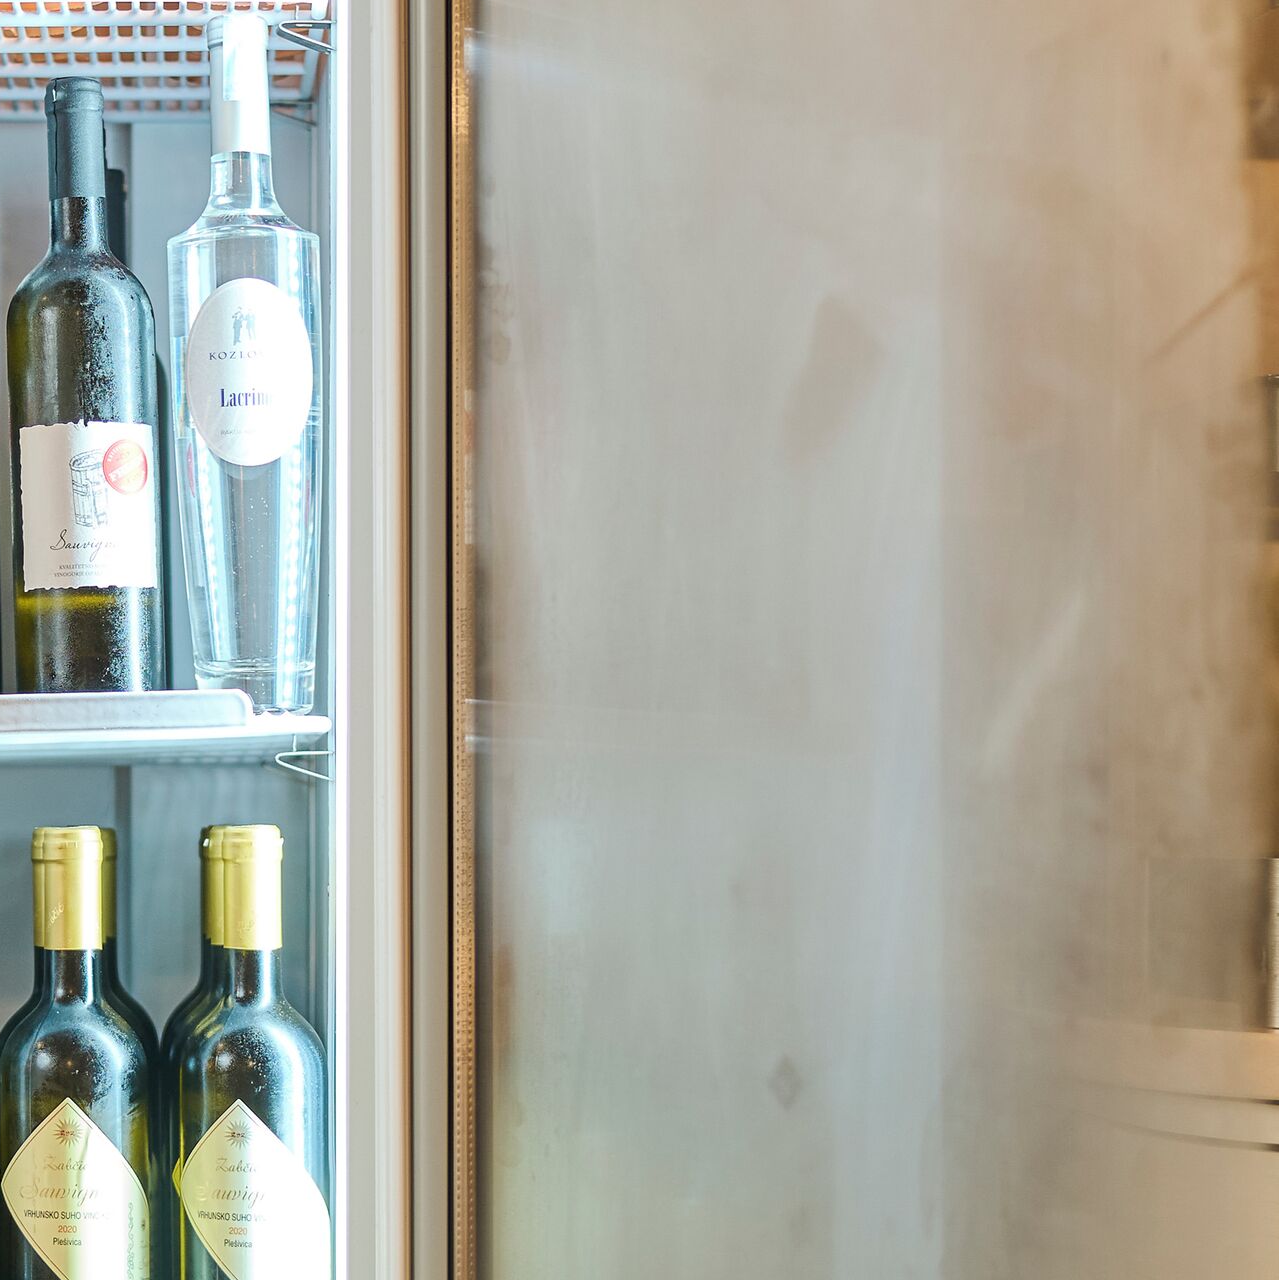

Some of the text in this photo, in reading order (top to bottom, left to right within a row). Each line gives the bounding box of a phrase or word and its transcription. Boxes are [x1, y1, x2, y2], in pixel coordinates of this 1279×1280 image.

[24, 1209, 82, 1220] VRHUNSKO SUHO
[198, 1211, 231, 1220] VRHUNSKO
[231, 1213, 253, 1221] SUHO
[58, 1225, 78, 1234] 2020
[228, 1227, 248, 1235] 2020
[52, 1237, 82, 1246] Plešivica
[223, 1238, 253, 1248] Plešivica
